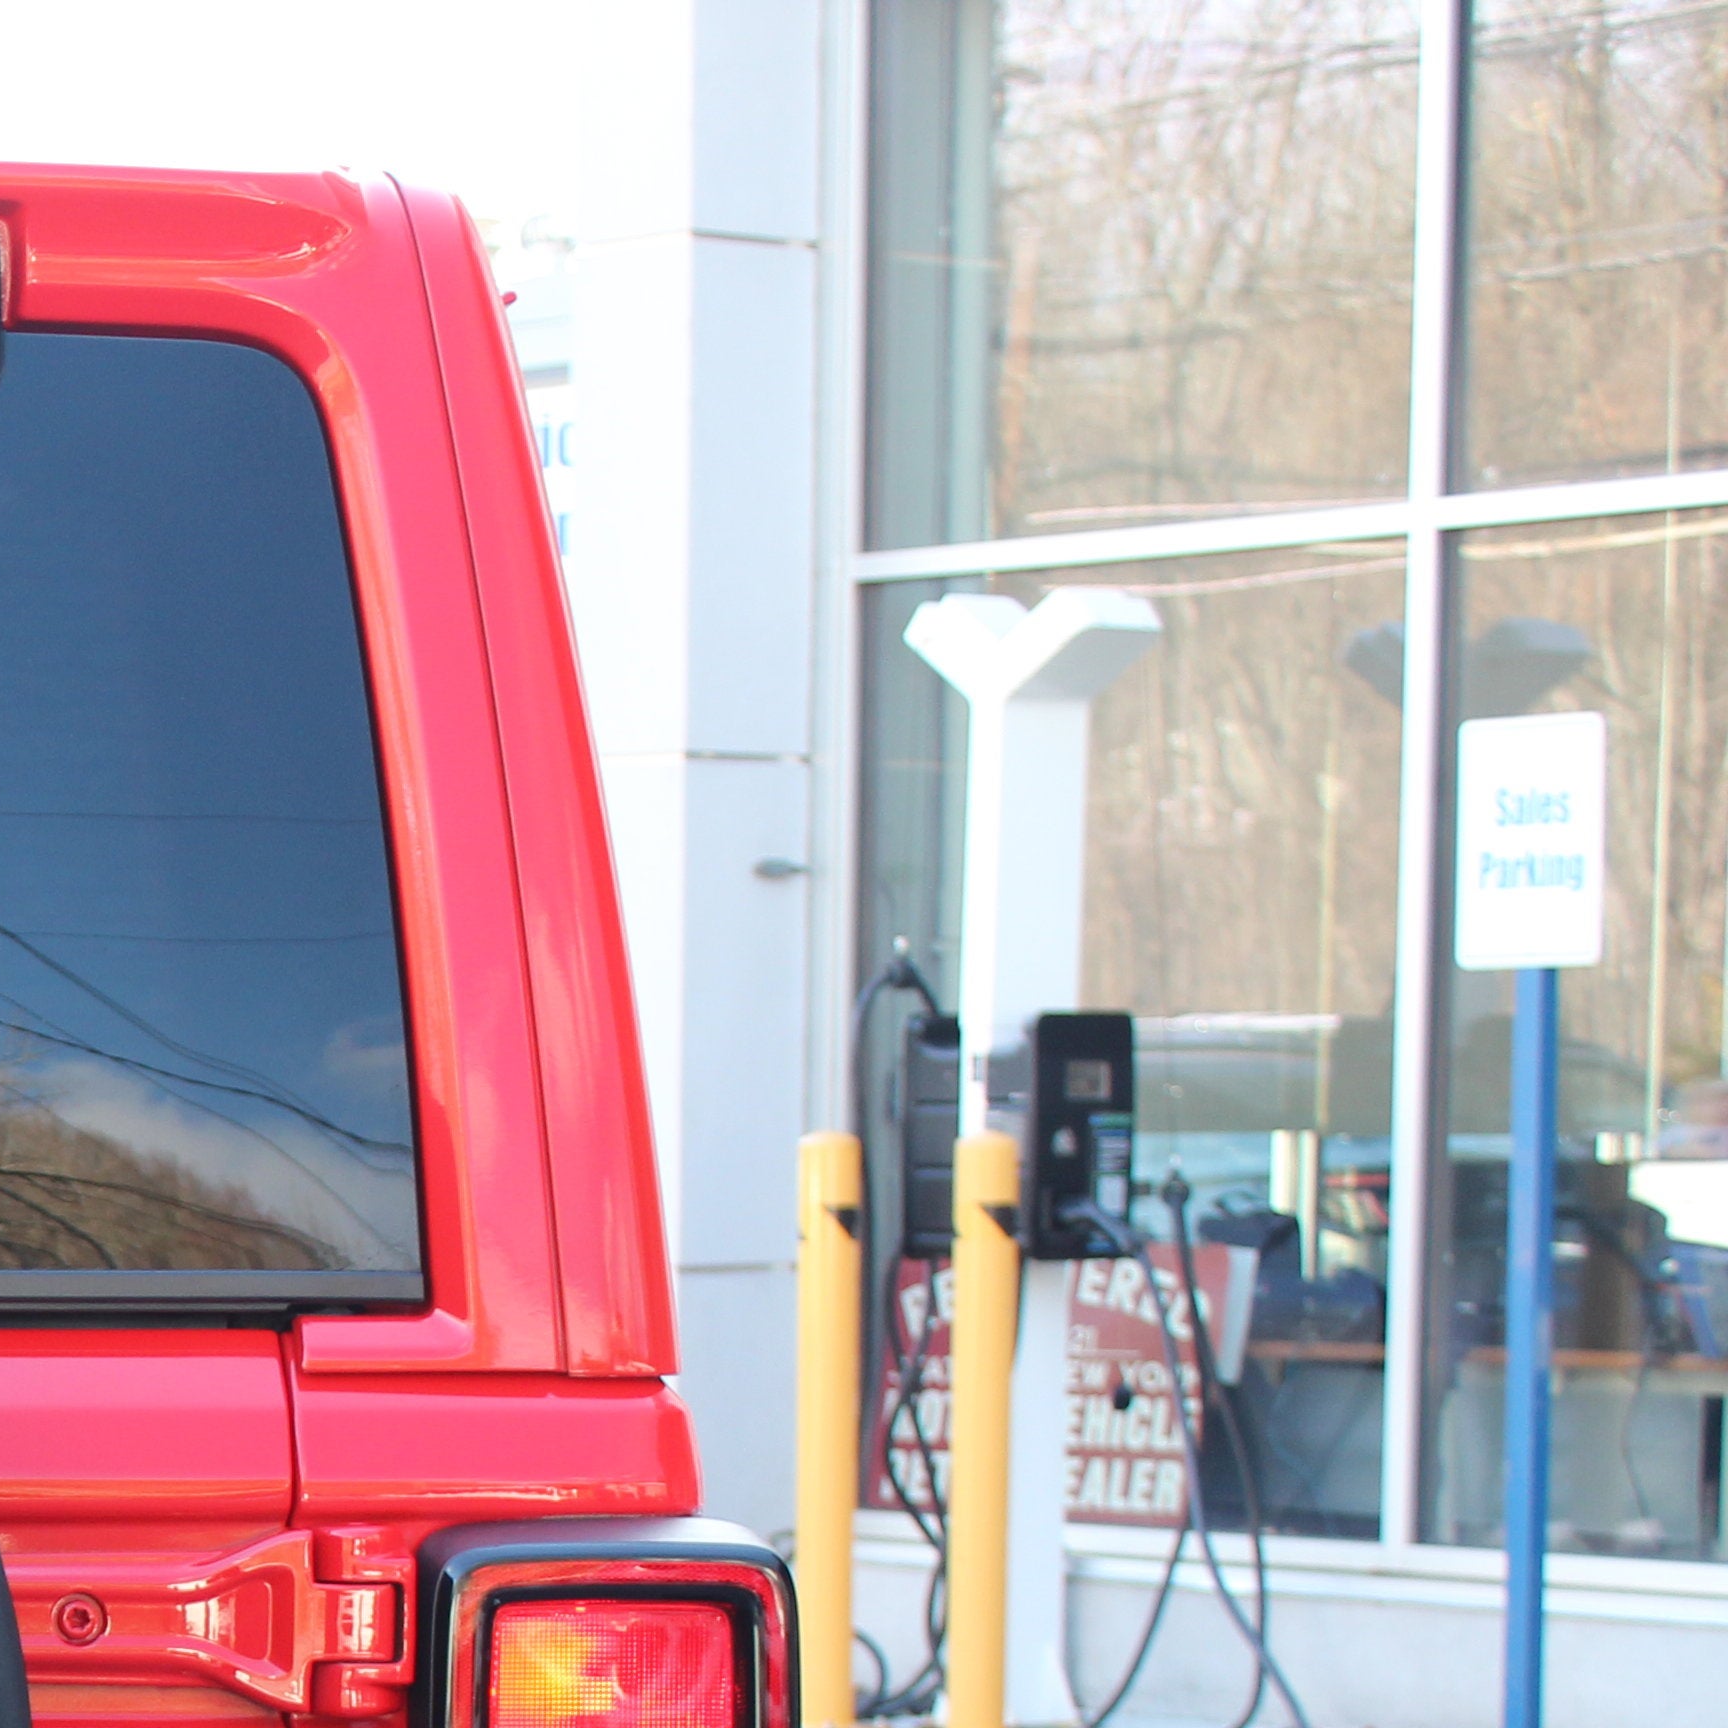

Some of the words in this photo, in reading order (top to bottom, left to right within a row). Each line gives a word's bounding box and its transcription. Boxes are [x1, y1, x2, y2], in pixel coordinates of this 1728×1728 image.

[1497, 787, 1570, 827] Sales
[1480, 852, 1584, 892] Parking
[1065, 1456, 1182, 1512] EALER
